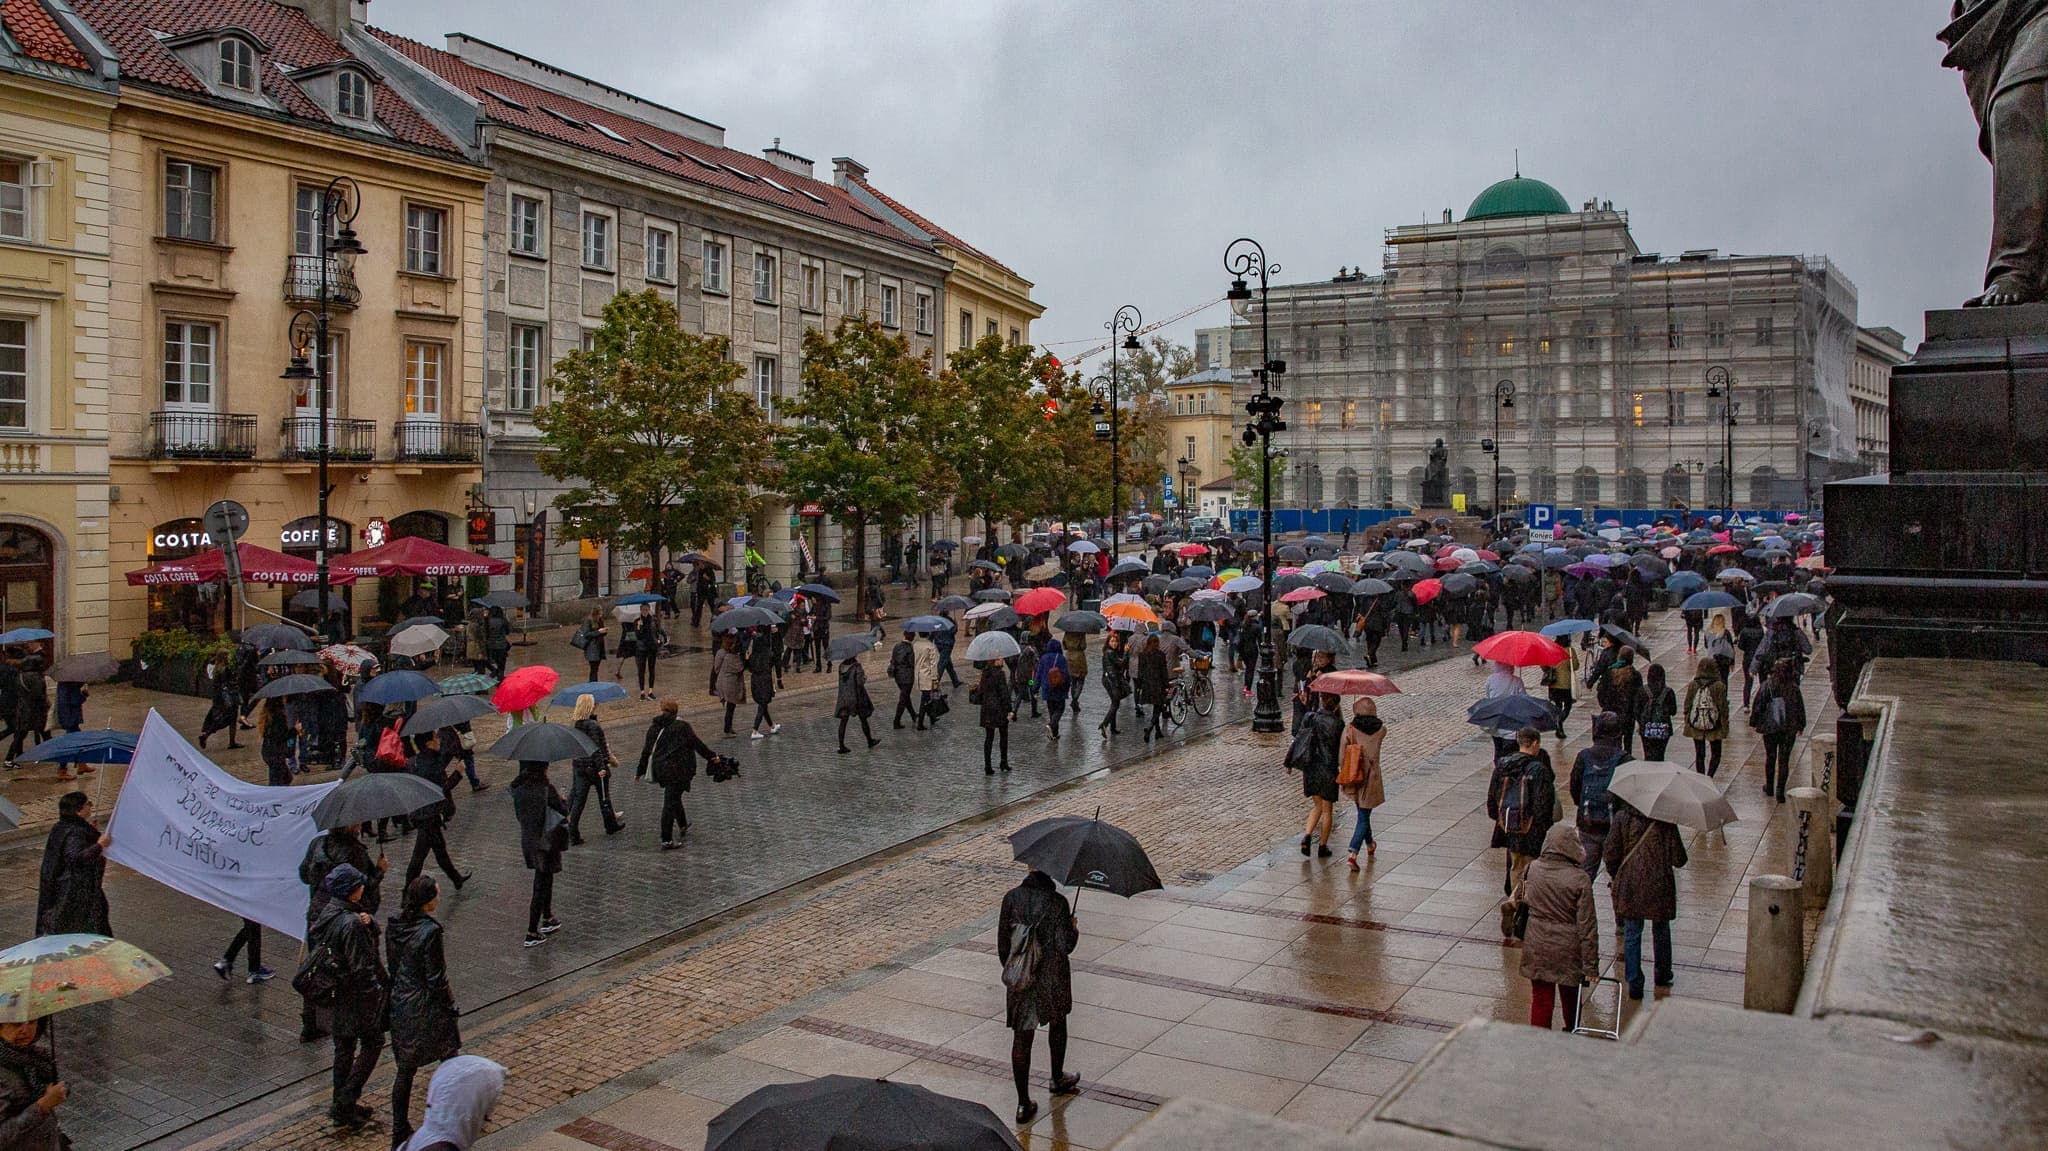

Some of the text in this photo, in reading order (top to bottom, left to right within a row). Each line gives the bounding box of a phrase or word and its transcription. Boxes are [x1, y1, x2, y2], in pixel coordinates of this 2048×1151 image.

[1535, 506, 1550, 527] P
[154, 532, 212, 548] COSTA
[281, 528, 337, 543] COFFE
[1530, 531, 1553, 540] Koniec
[426, 565, 490, 575] COSTA COFFEE
[144, 572, 200, 583] COSTA COFFEE
[252, 572, 331, 582] COSTA COFF
